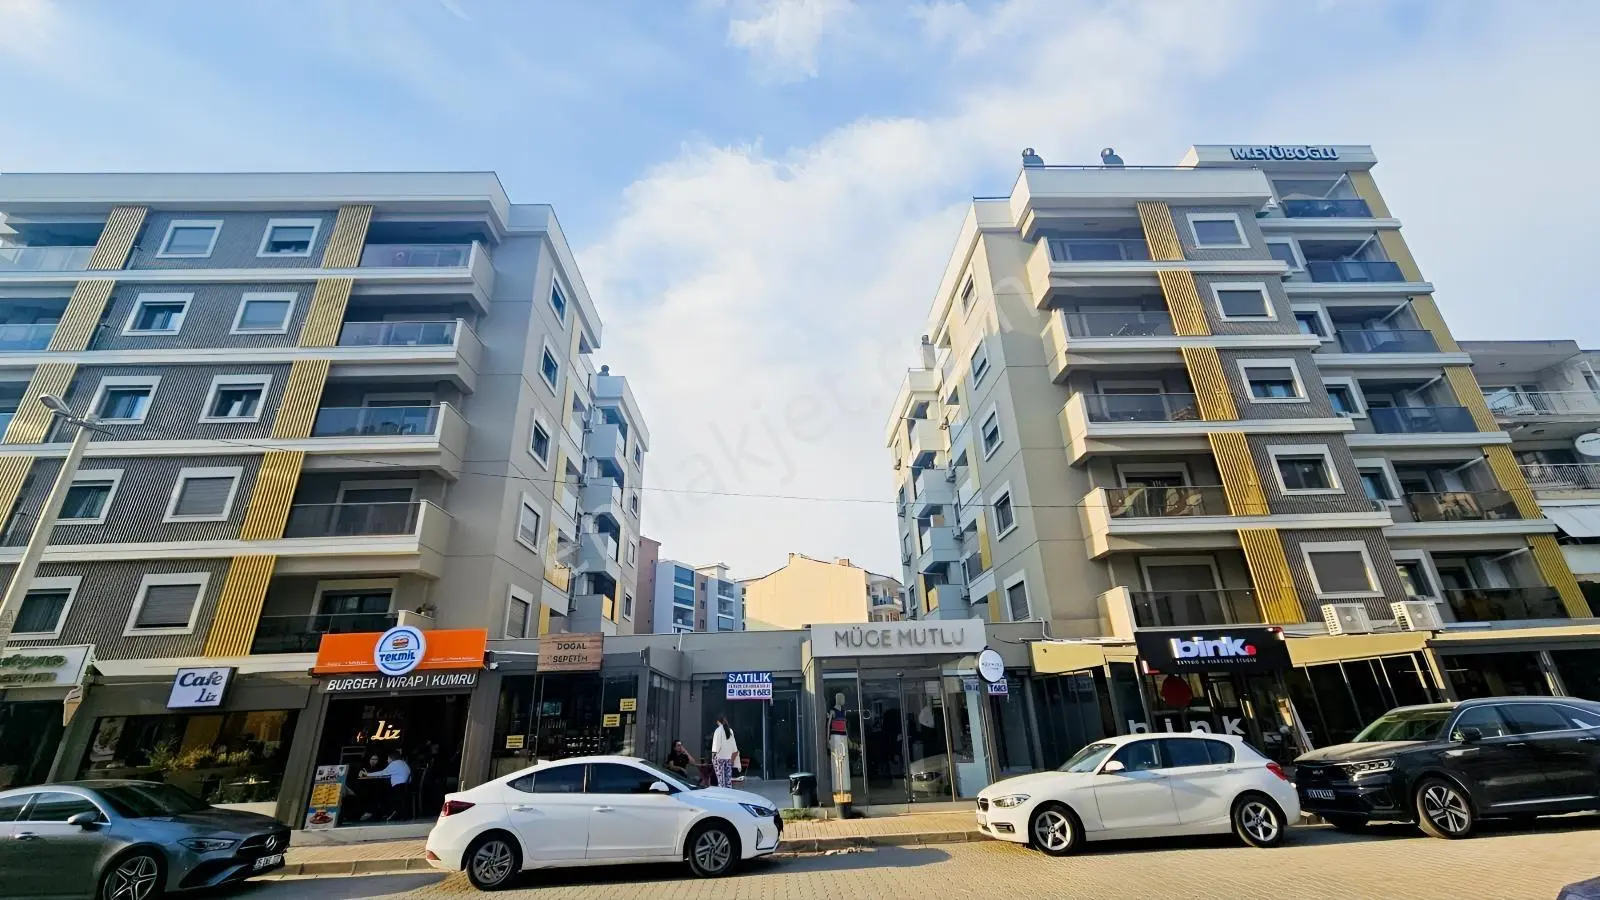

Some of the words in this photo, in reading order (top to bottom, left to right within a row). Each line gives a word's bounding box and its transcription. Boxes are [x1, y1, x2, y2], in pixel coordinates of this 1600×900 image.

[834, 626, 892, 648] MÜGE
[897, 627, 965, 646] MUTLU
[557, 641, 587, 650] DOĞAL
[179, 671, 223, 687] Cafe
[327, 678, 378, 690] BURGER
[385, 675, 424, 688] WRAP
[431, 673, 476, 686] KUMRU
[728, 673, 771, 682] SATILIK
[194, 688, 218, 703] Liz
[370, 720, 401, 740] Liz
